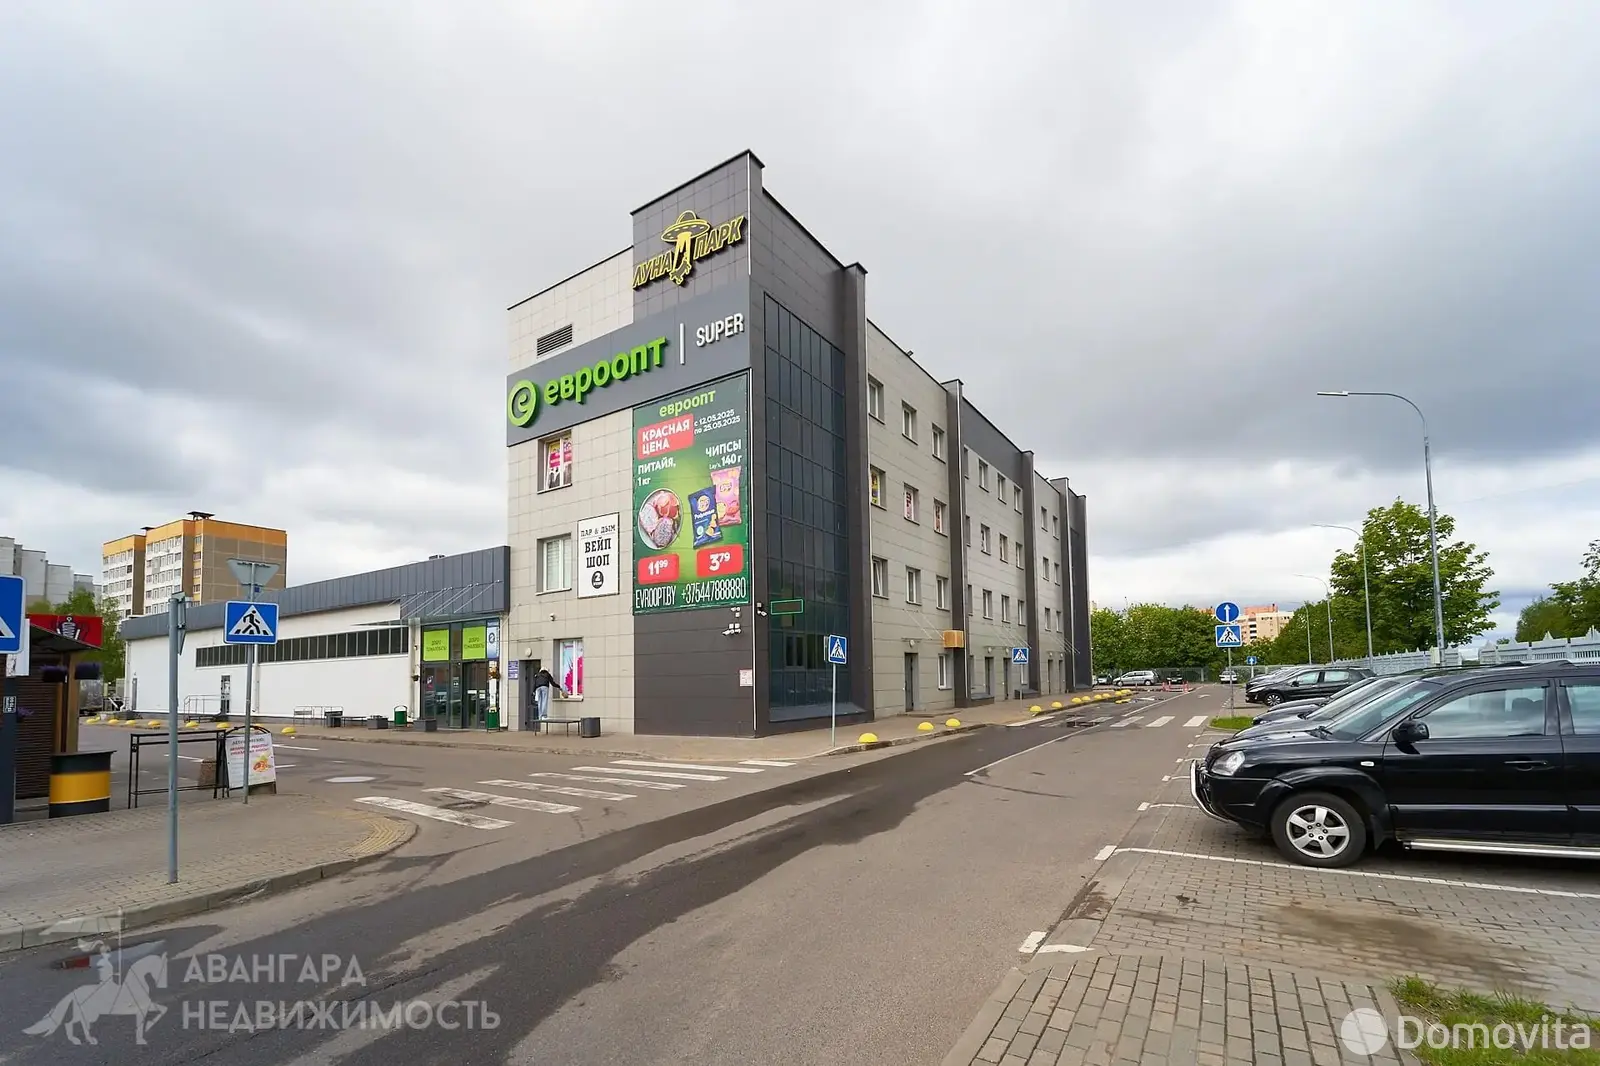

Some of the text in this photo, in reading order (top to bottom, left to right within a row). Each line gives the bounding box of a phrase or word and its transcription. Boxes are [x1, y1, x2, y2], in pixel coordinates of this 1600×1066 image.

[632, 216, 744, 288] ЛУНА ПАРК
[696, 312, 744, 347] SUPER
[543, 336, 667, 404] евроопт
[659, 390, 716, 416] евроопт
[699, 409, 735, 425] 12.05.2025
[703, 415, 741, 432] 25.05.2025
[642, 419, 690, 442] КРАСНАЯ
[642, 439, 670, 455] ЦЕНА
[705, 439, 742, 457] ЧИПСЫ
[637, 457, 677, 475] ПИТАЙЯ,
[721, 453, 737, 466] 140
[737, 455, 742, 463] г
[637, 477, 651, 487] 1 кг
[580, 528, 592, 537] ПАР
[600, 524, 616, 534] ДЫМ
[584, 536, 612, 554] ВЕЙП
[586, 554, 610, 568] ШОП
[635, 586, 677, 609] EVROOPT.BY
